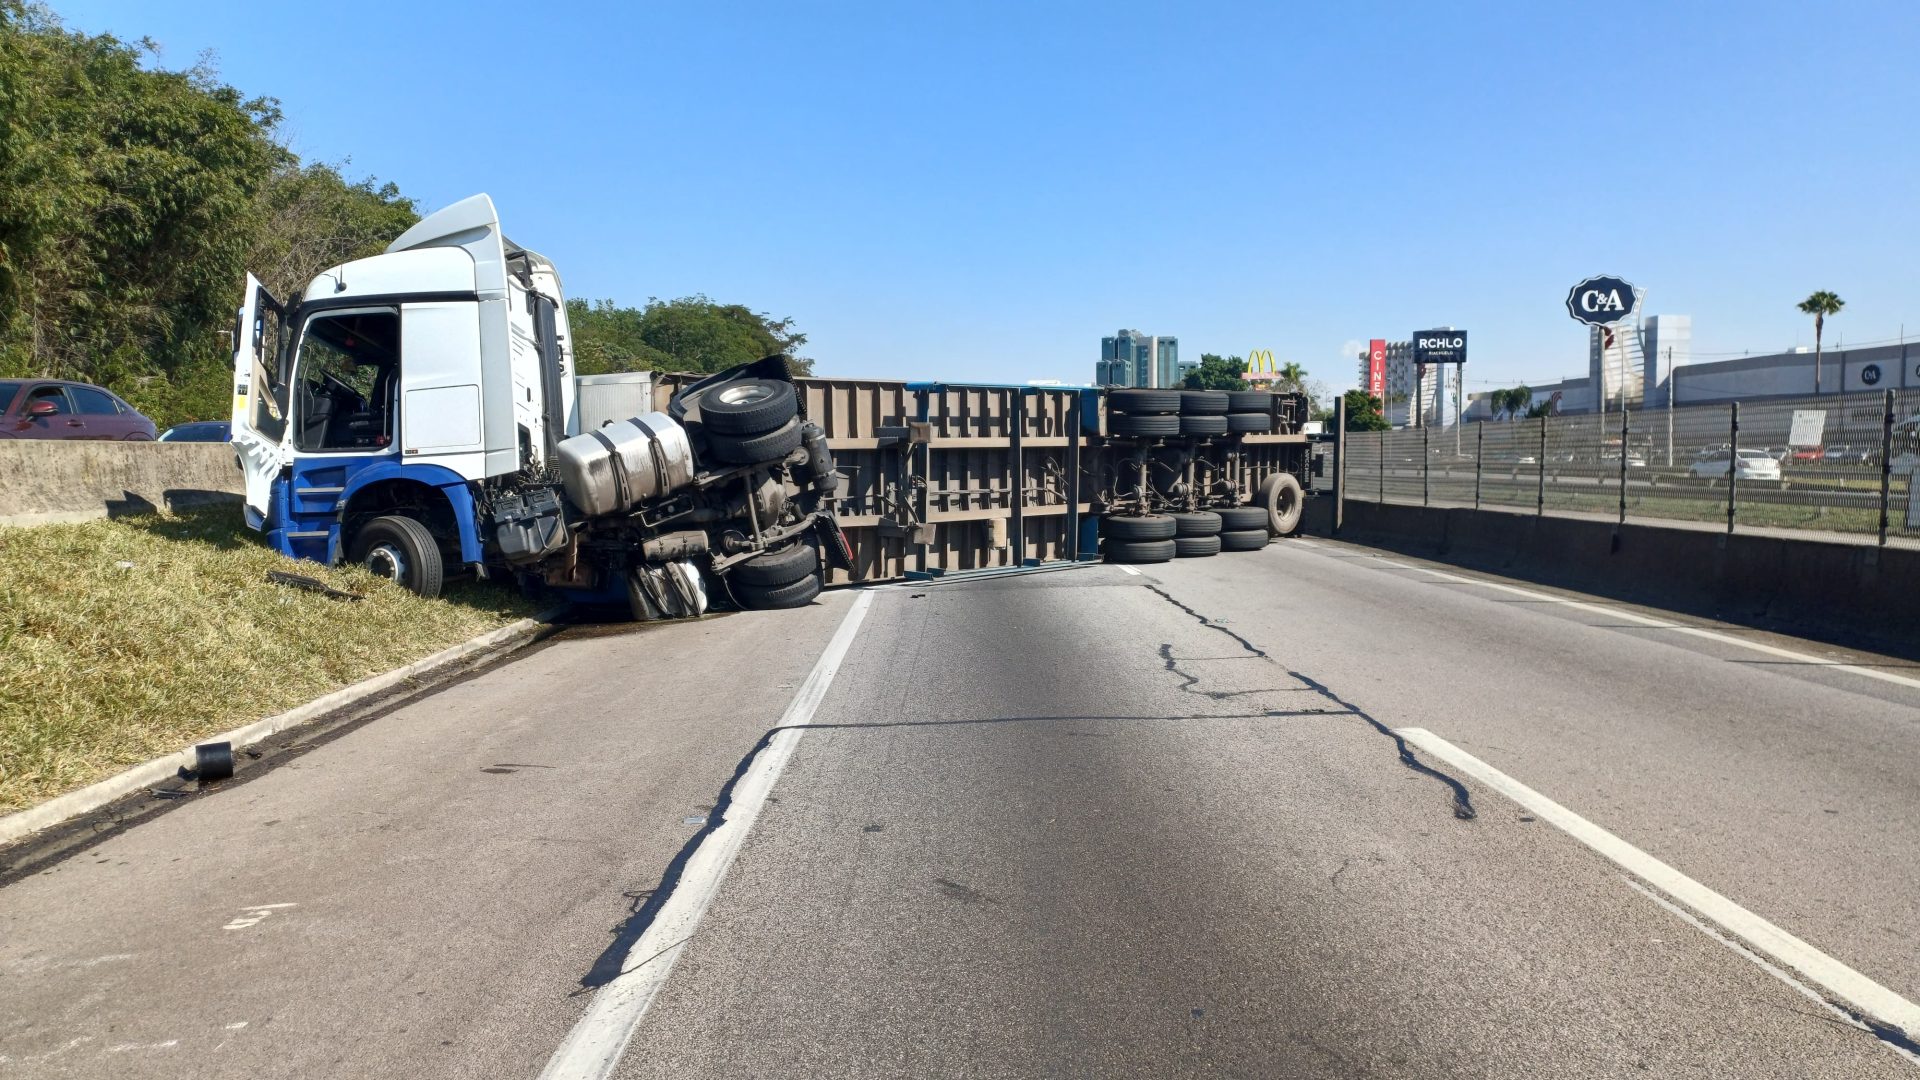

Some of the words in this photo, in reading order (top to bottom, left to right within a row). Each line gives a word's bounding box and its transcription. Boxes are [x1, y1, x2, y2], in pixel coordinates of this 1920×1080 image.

[1581, 288, 1625, 312] C&A
[1419, 337, 1463, 349] RCHLO
[1373, 350, 1383, 399] CINEM
